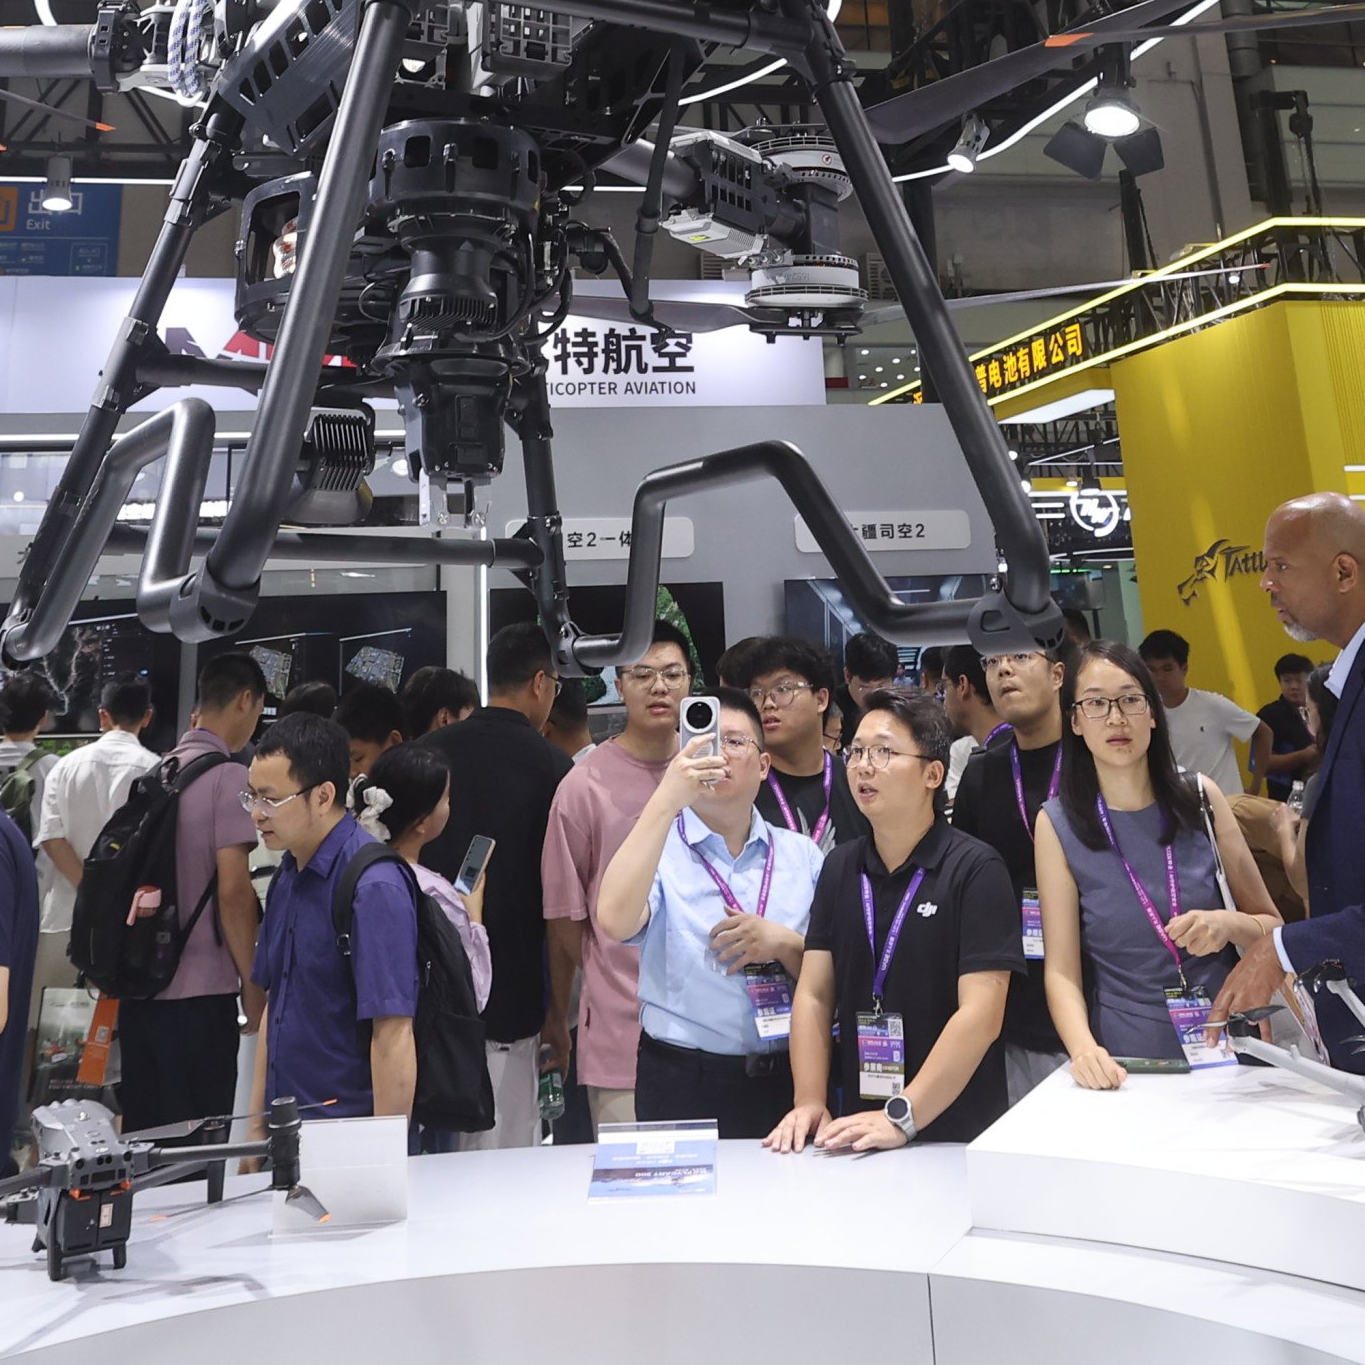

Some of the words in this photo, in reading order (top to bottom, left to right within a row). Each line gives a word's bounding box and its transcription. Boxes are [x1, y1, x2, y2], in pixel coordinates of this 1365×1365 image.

[26, 219, 51, 231] Exit
[546, 381, 618, 396] ICOPTER
[624, 381, 696, 395] AVIATION
